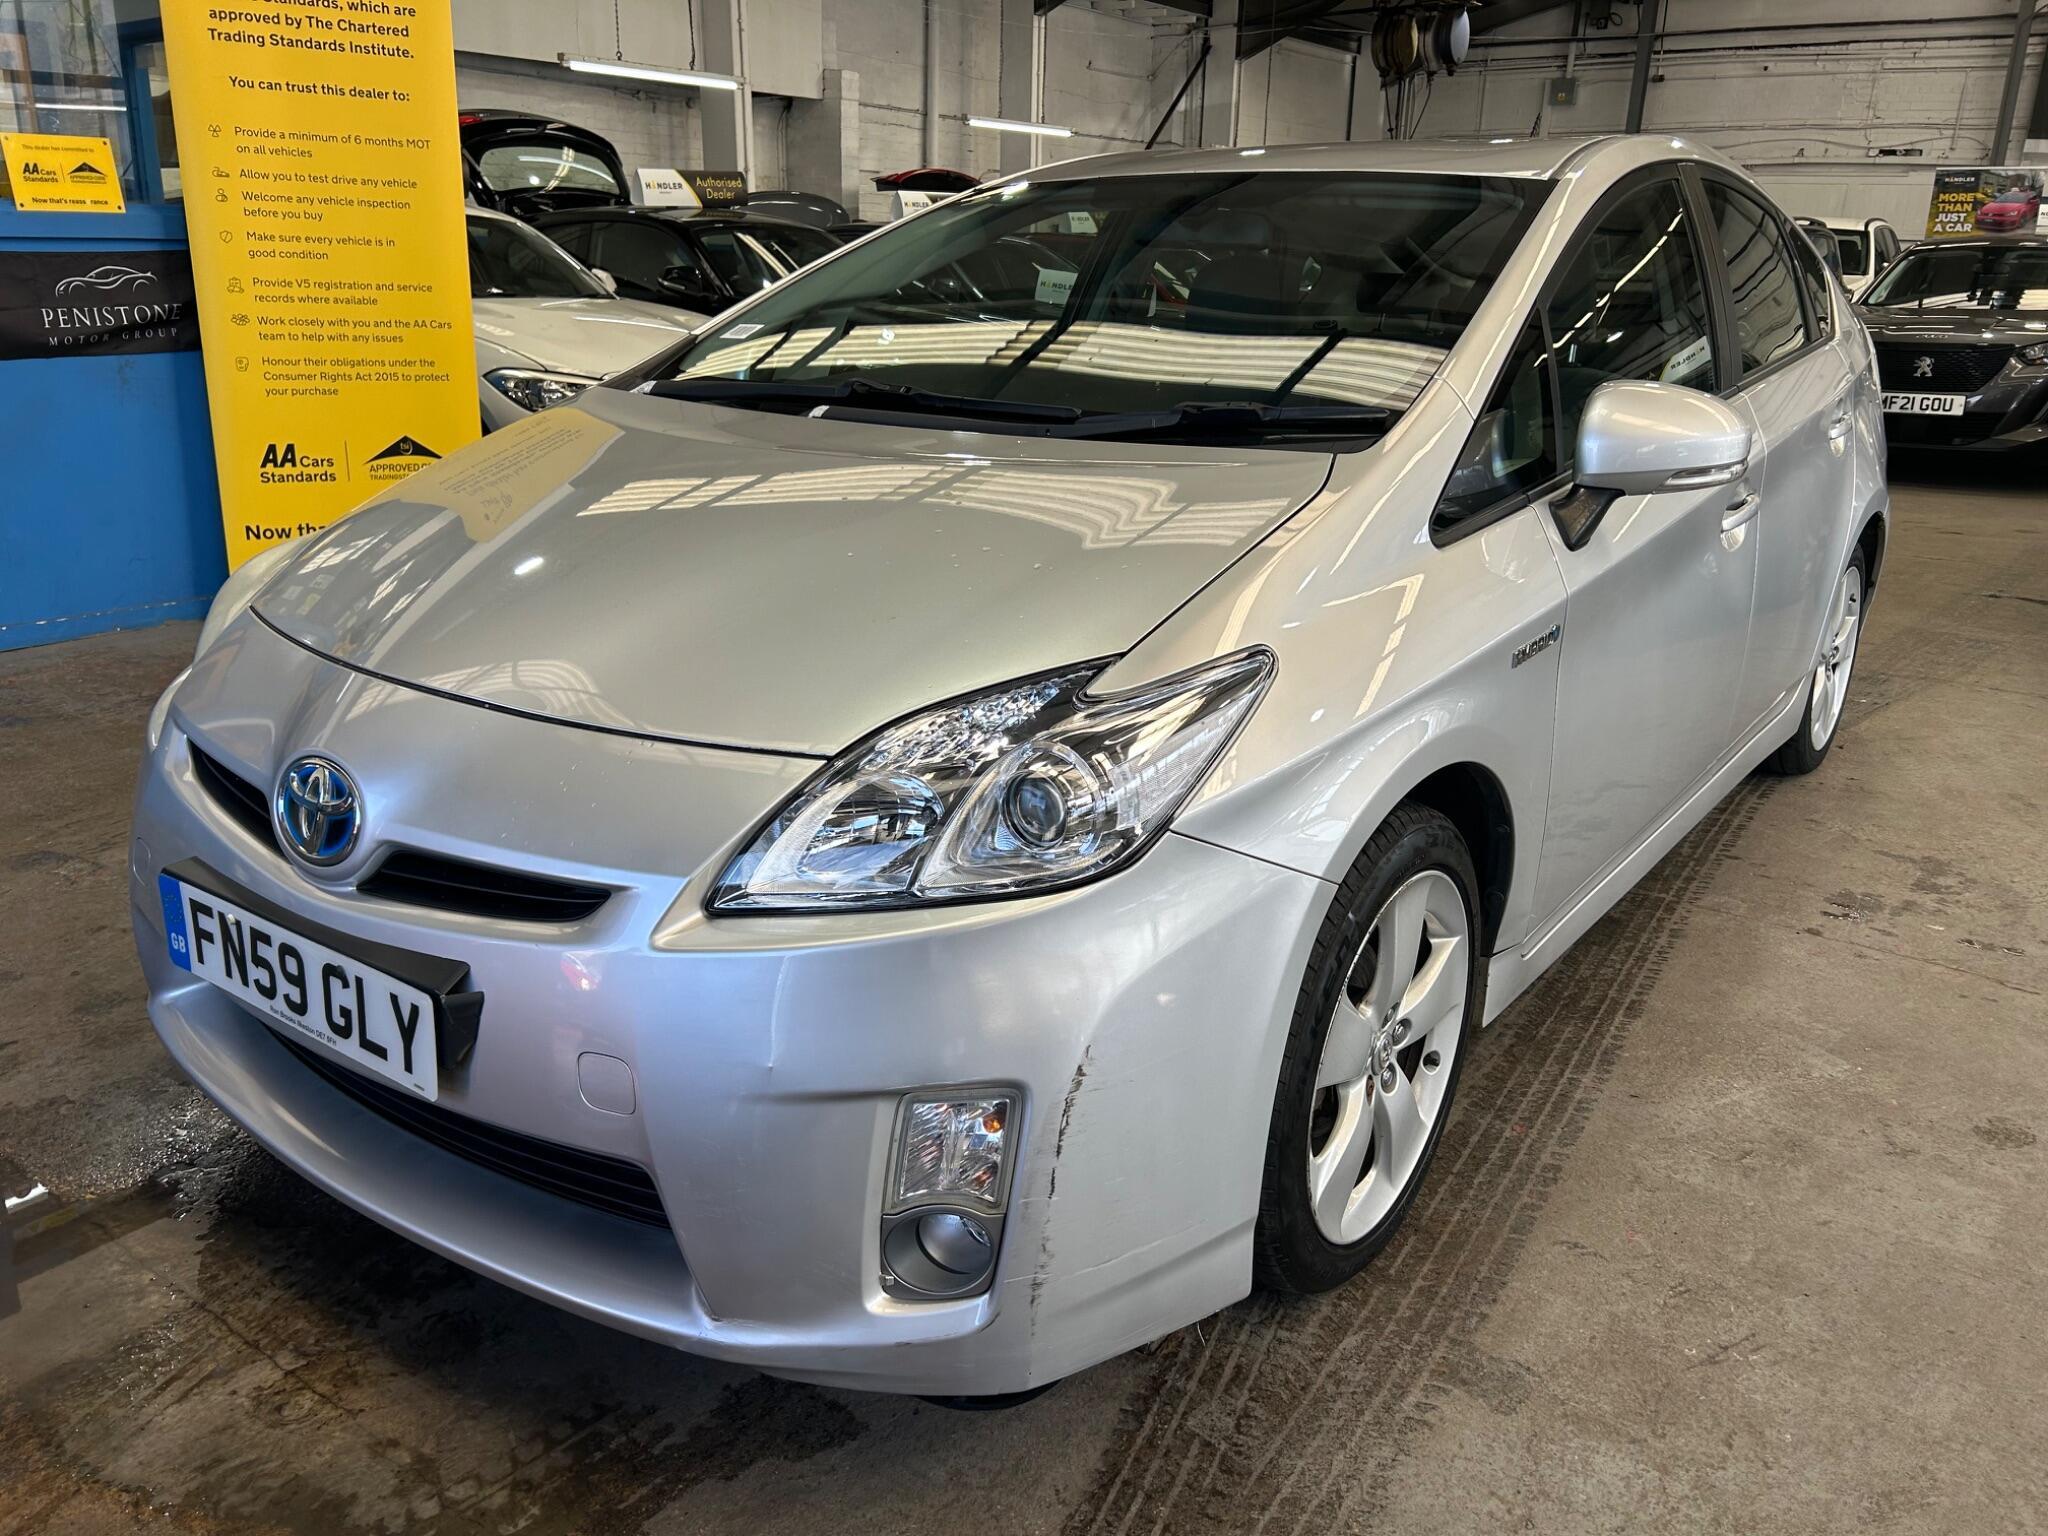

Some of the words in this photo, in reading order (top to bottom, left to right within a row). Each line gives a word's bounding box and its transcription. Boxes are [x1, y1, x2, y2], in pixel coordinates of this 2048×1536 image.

[348, 0, 389, 15] which
[394, 6, 416, 17] are
[209, 9, 280, 25] approved
[285, 14, 302, 29] by
[306, 16, 332, 29] The
[337, 19, 409, 37] Chartered
[208, 28, 265, 47] Trading
[270, 34, 345, 52] Standards
[350, 41, 414, 58] Institute.
[229, 76, 254, 88] You
[259, 80, 282, 91] can
[286, 81, 317, 94] trust
[321, 84, 345, 96] this
[350, 87, 388, 100] dealer
[393, 90, 410, 101] to:
[235, 126, 276, 139] Provide
[288, 131, 338, 143] minimum
[341, 134, 351, 143] of
[354, 135, 361, 144] 6
[365, 137, 404, 148] months
[407, 139, 430, 149] MOT
[236, 145, 250, 153] on
[254, 145, 266, 155] all
[268, 146, 313, 158] vehicles
[23, 162, 39, 174] AA
[240, 169, 270, 180] Allow
[272, 173, 292, 182] you
[295, 172, 306, 182] to
[308, 174, 329, 184] test
[332, 175, 358, 185] drive
[361, 178, 378, 188] any
[381, 178, 417, 189] vehicle
[696, 177, 742, 188] Authorised
[241, 191, 293, 203] Welcome
[296, 196, 315, 206] any
[317, 196, 354, 206] vehicle
[357, 198, 411, 209] inspection
[706, 188, 736, 199] Dealer
[1939, 193, 1975, 201] MORE
[1938, 203, 1972, 211] THAN
[244, 207, 279, 218] before
[281, 211, 300, 220] you
[304, 210, 323, 222] buy
[1935, 213, 1967, 222] JUST
[1933, 223, 1943, 232] A
[1946, 223, 1972, 232] CAR
[246, 231, 276, 242] Make
[278, 235, 302, 243] sure
[304, 236, 333, 246] every
[336, 236, 372, 246] vehicle
[375, 237, 384, 247] is
[386, 237, 395, 247] in
[248, 249, 276, 259] good
[279, 250, 328, 260] condition
[252, 277, 293, 288] Provide
[295, 279, 310, 289] V5
[313, 280, 372, 291] registration
[376, 282, 394, 291] and
[397, 283, 432, 292] service
[254, 294, 295, 303] records
[297, 294, 330, 304] where
[332, 296, 378, 305] available
[40, 304, 182, 328] PENISTONE
[256, 316, 285, 326] Work
[288, 317, 325, 328] closely
[327, 318, 350, 327] with
[352, 320, 370, 329] you
[374, 320, 392, 328] and
[394, 320, 410, 328] the
[413, 320, 428, 329] AA
[430, 320, 452, 330] Cars
[49, 333, 110, 346] MOTOR
[122, 328, 177, 339] GROUP
[259, 332, 285, 340] team
[288, 332, 299, 340] to
[301, 332, 324, 342] help
[326, 333, 349, 342] with
[352, 334, 370, 344] any
[372, 333, 404, 343] issues
[262, 356, 301, 366] Honour
[303, 357, 327, 366] their
[330, 357, 386, 368] obligations
[388, 358, 417, 367] under
[420, 358, 436, 367] the
[263, 371, 317, 381] Consumer
[320, 372, 353, 383] Rights
[355, 372, 372, 381] Act
[375, 372, 399, 381] 2015
[402, 373, 412, 381] to
[414, 372, 450, 382] protect
[265, 388, 288, 397] your
[291, 386, 338, 397] purchase
[1920, 397, 1954, 412] GOU
[260, 443, 297, 468] AA
[300, 456, 334, 467] Cars
[370, 464, 419, 472] APPROVED
[260, 471, 337, 484] Standards
[245, 524, 292, 540] Now
[171, 932, 186, 953] GB
[188, 897, 308, 1017] FN59
[322, 962, 420, 1075] GLY
